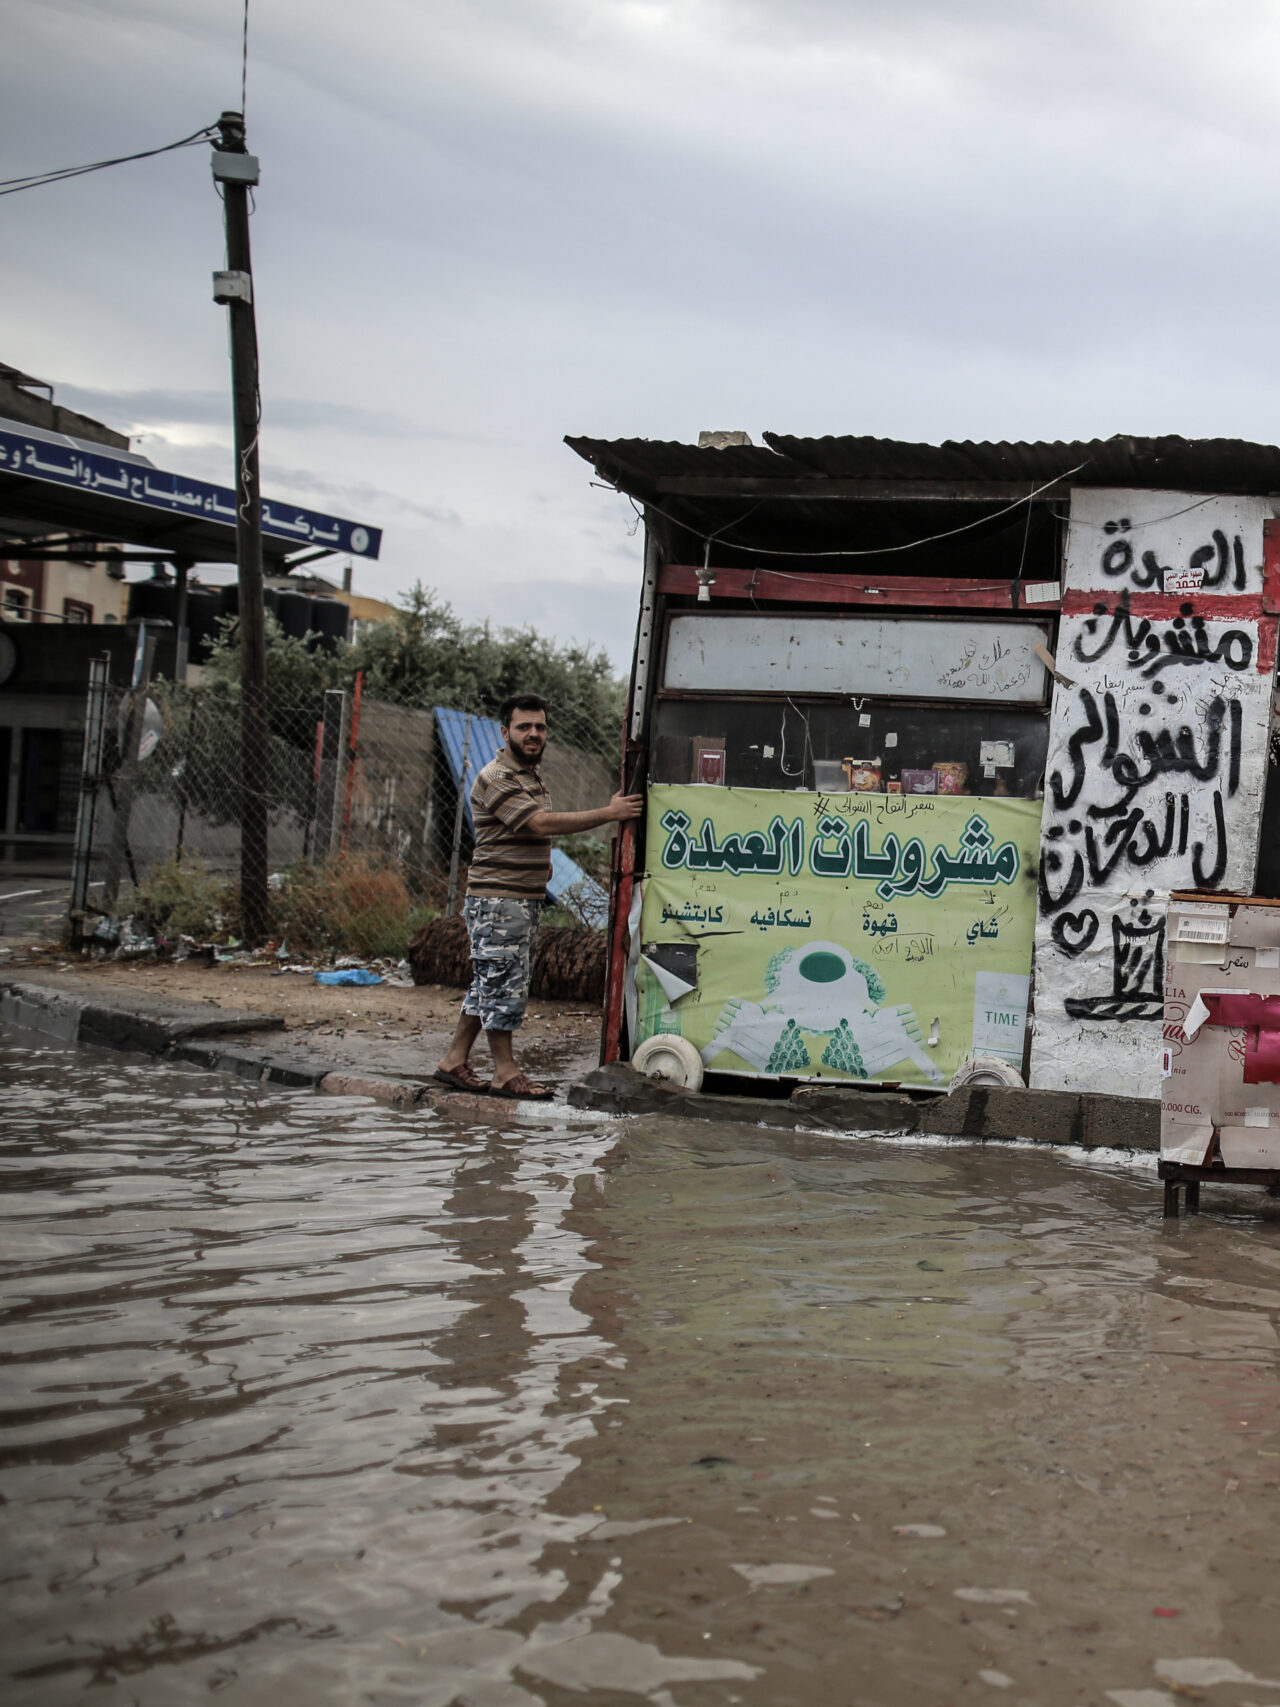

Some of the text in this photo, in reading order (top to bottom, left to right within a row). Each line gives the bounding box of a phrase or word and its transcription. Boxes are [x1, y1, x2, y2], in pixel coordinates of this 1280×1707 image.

[130, 475, 203, 507] مصباح
[262, 505, 340, 542] شركة
[660, 810, 1020, 901] مشروبات العمدة
[750, 905, 812, 930] نسكافيه
[862, 913, 898, 937] قهوة
[966, 916, 999, 946] شاي
[984, 1010, 1020, 1027] TIME
[1184, 1104, 1203, 1116] CIG.
